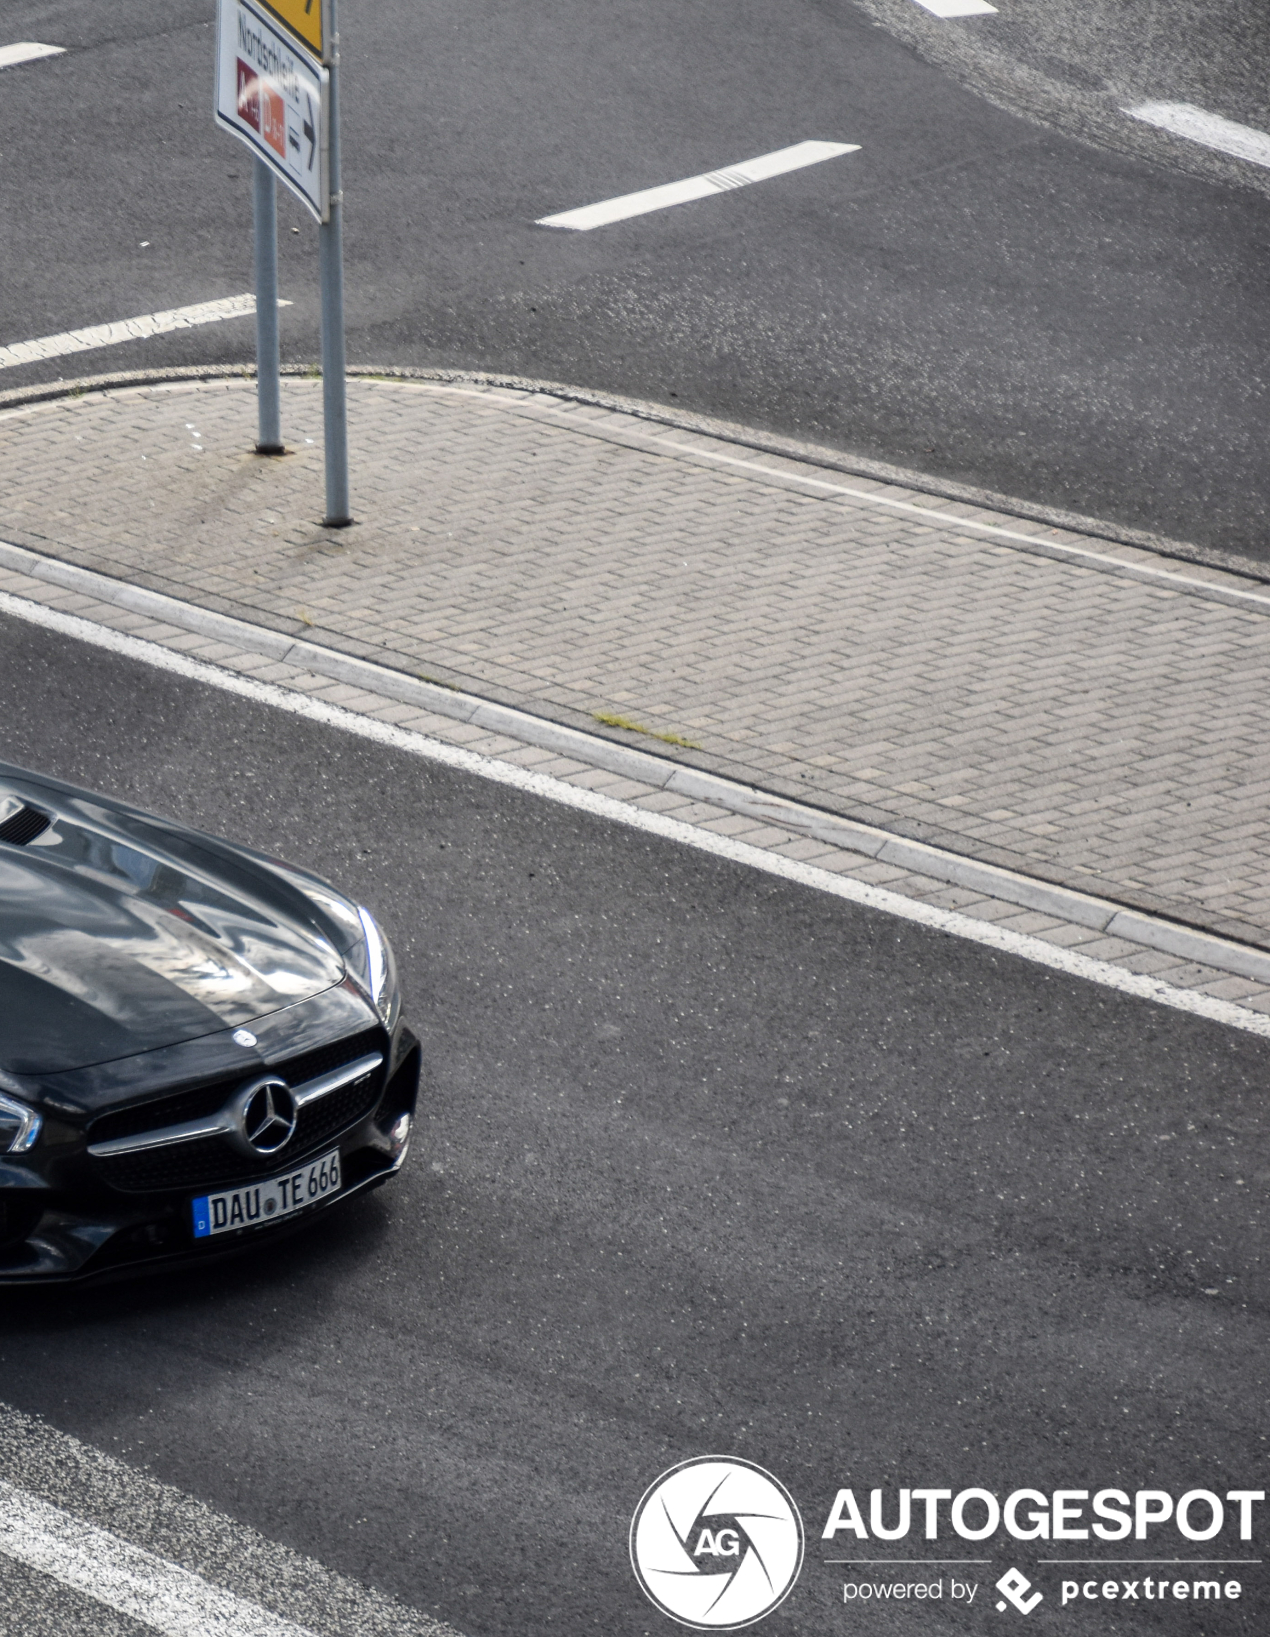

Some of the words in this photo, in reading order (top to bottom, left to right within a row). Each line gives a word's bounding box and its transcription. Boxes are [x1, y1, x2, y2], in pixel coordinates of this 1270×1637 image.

[237, 10, 300, 104] Nordschleife
[198, 1220, 205, 1230] D
[211, 1188, 261, 1229] DAU
[278, 1173, 304, 1209] TE
[308, 1155, 339, 1198] 666
